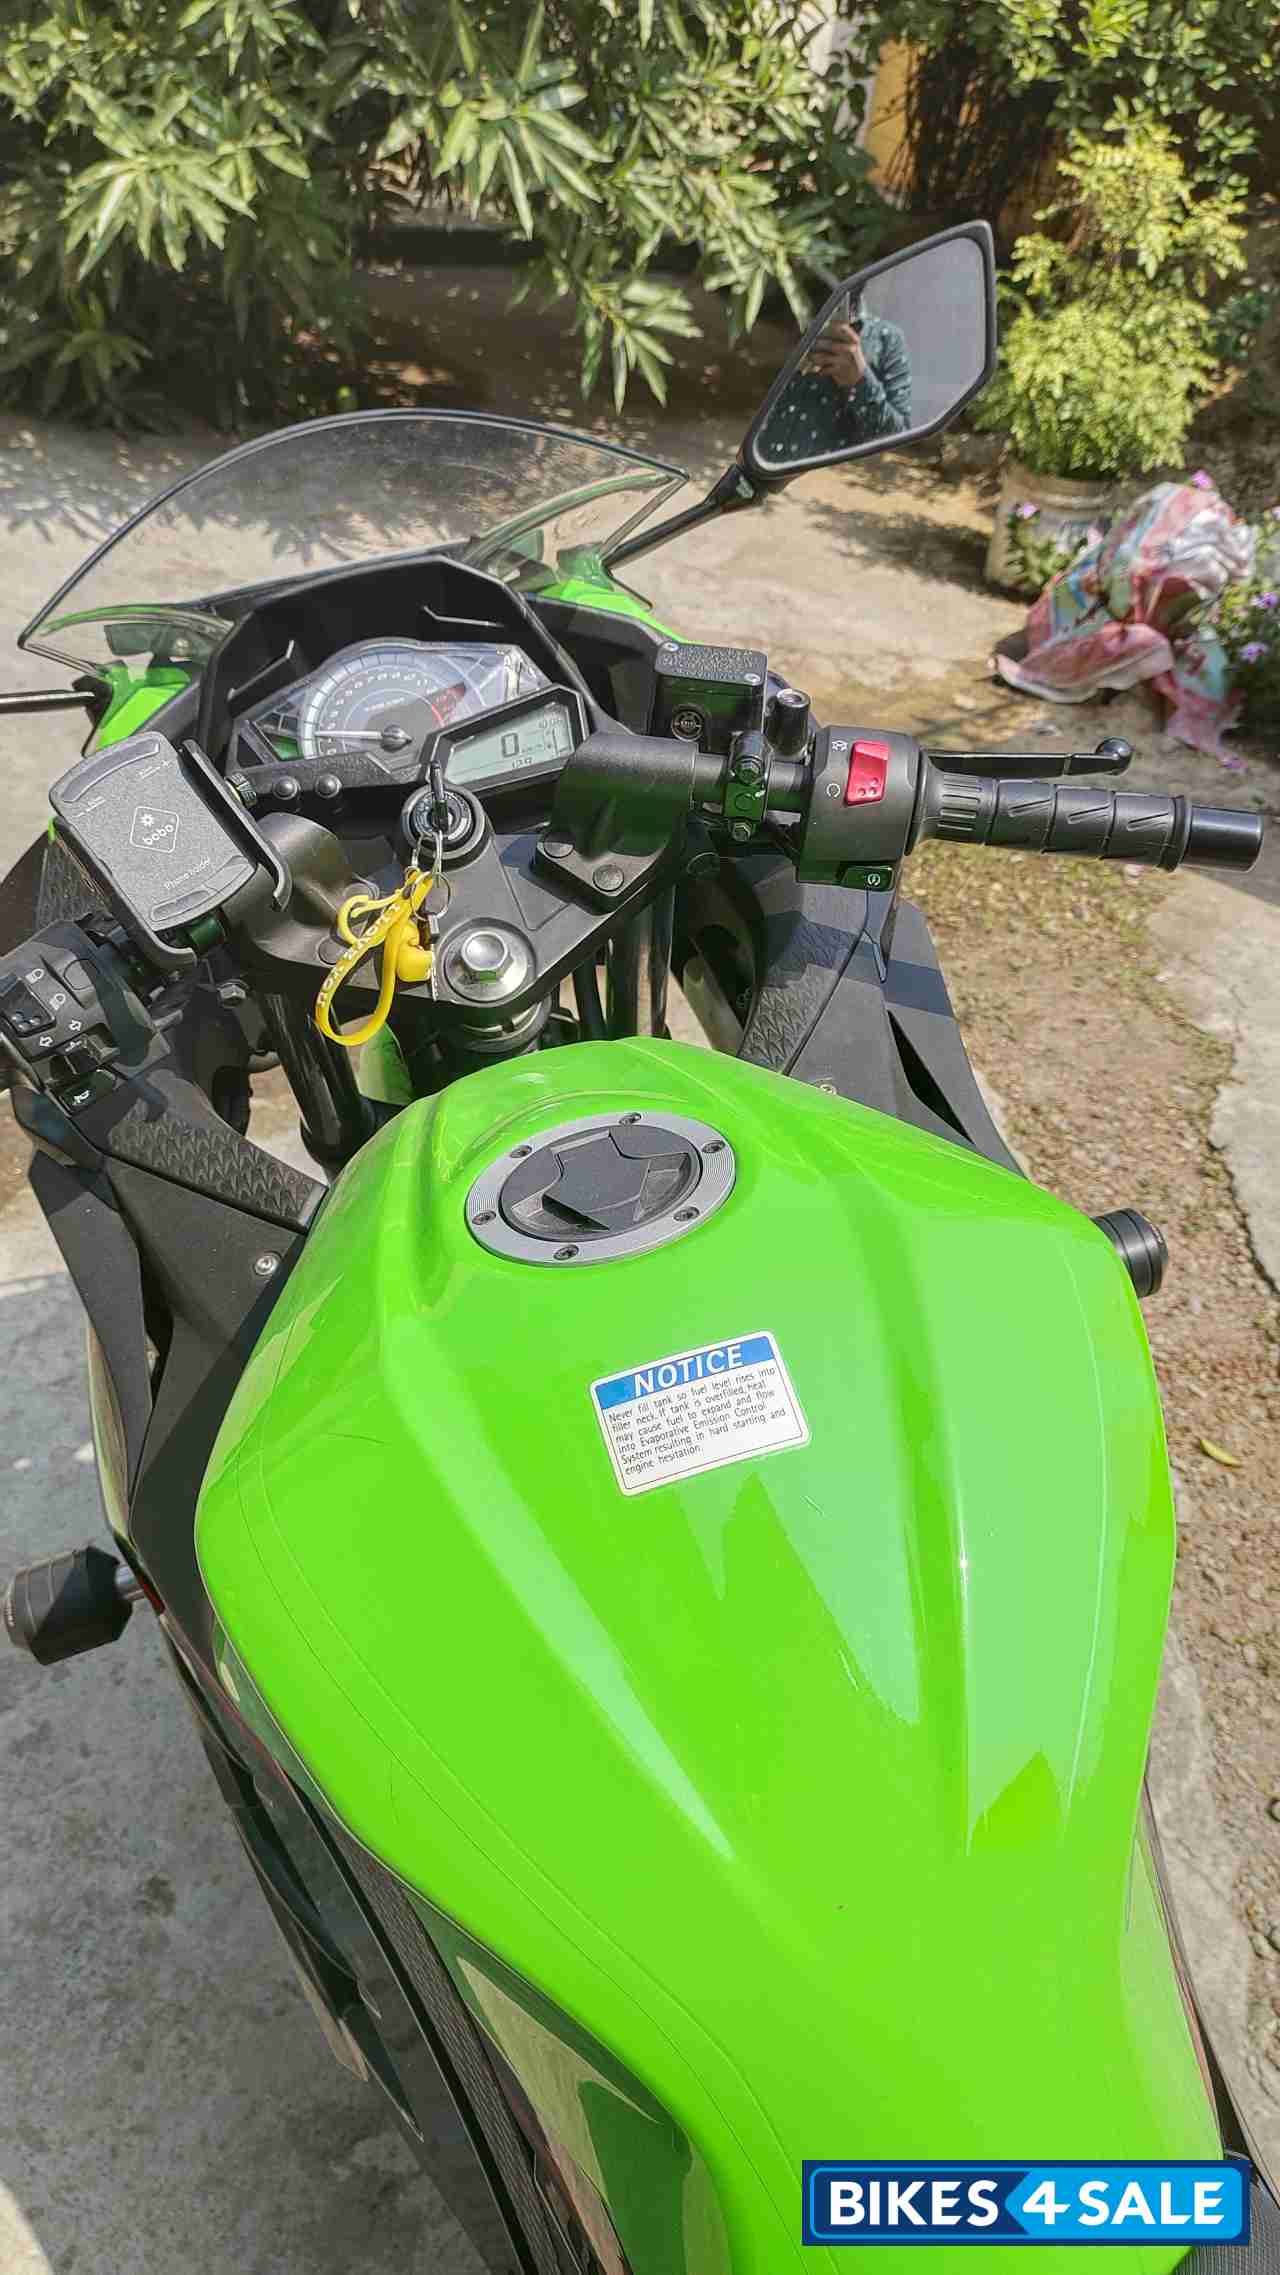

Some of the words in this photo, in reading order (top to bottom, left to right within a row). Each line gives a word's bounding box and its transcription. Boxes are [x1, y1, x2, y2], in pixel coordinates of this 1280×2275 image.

[502, 733, 518, 758] 0
[142, 824, 174, 845] bobo
[609, 1409, 632, 1422] Never
[638, 1402, 649, 1413] fill
[654, 1394, 672, 1407] tank
[677, 1391, 687, 1401] so
[691, 1384, 707, 1396] fuel
[712, 1377, 731, 1390] level
[735, 1374, 754, 1385] rises
[759, 1367, 775, 1377] into
[634, 1345, 743, 1397] NOTICE
[612, 1421, 630, 1432] filler
[670, 1401, 689, 1414] tank
[616, 1432, 633, 1443] may
[638, 1423, 661, 1435] cause
[666, 1415, 683, 1426] fuel
[688, 1411, 697, 1420] to
[702, 1400, 731, 1417] expand
[736, 1395, 752, 1406] and
[755, 1389, 775, 1401] flow
[618, 1442, 636, 1453] into
[640, 1424, 689, 1447] Evaporative
[693, 1413, 730, 1430] Emission
[734, 1402, 767, 1417] Control
[621, 1448, 653, 1465] System
[655, 1435, 692, 1453] resulting
[696, 1430, 705, 1440] in
[709, 1423, 728, 1436] hard
[732, 1414, 766, 1430] starting
[770, 1407, 786, 1419] and
[625, 1459, 656, 1475] engine
